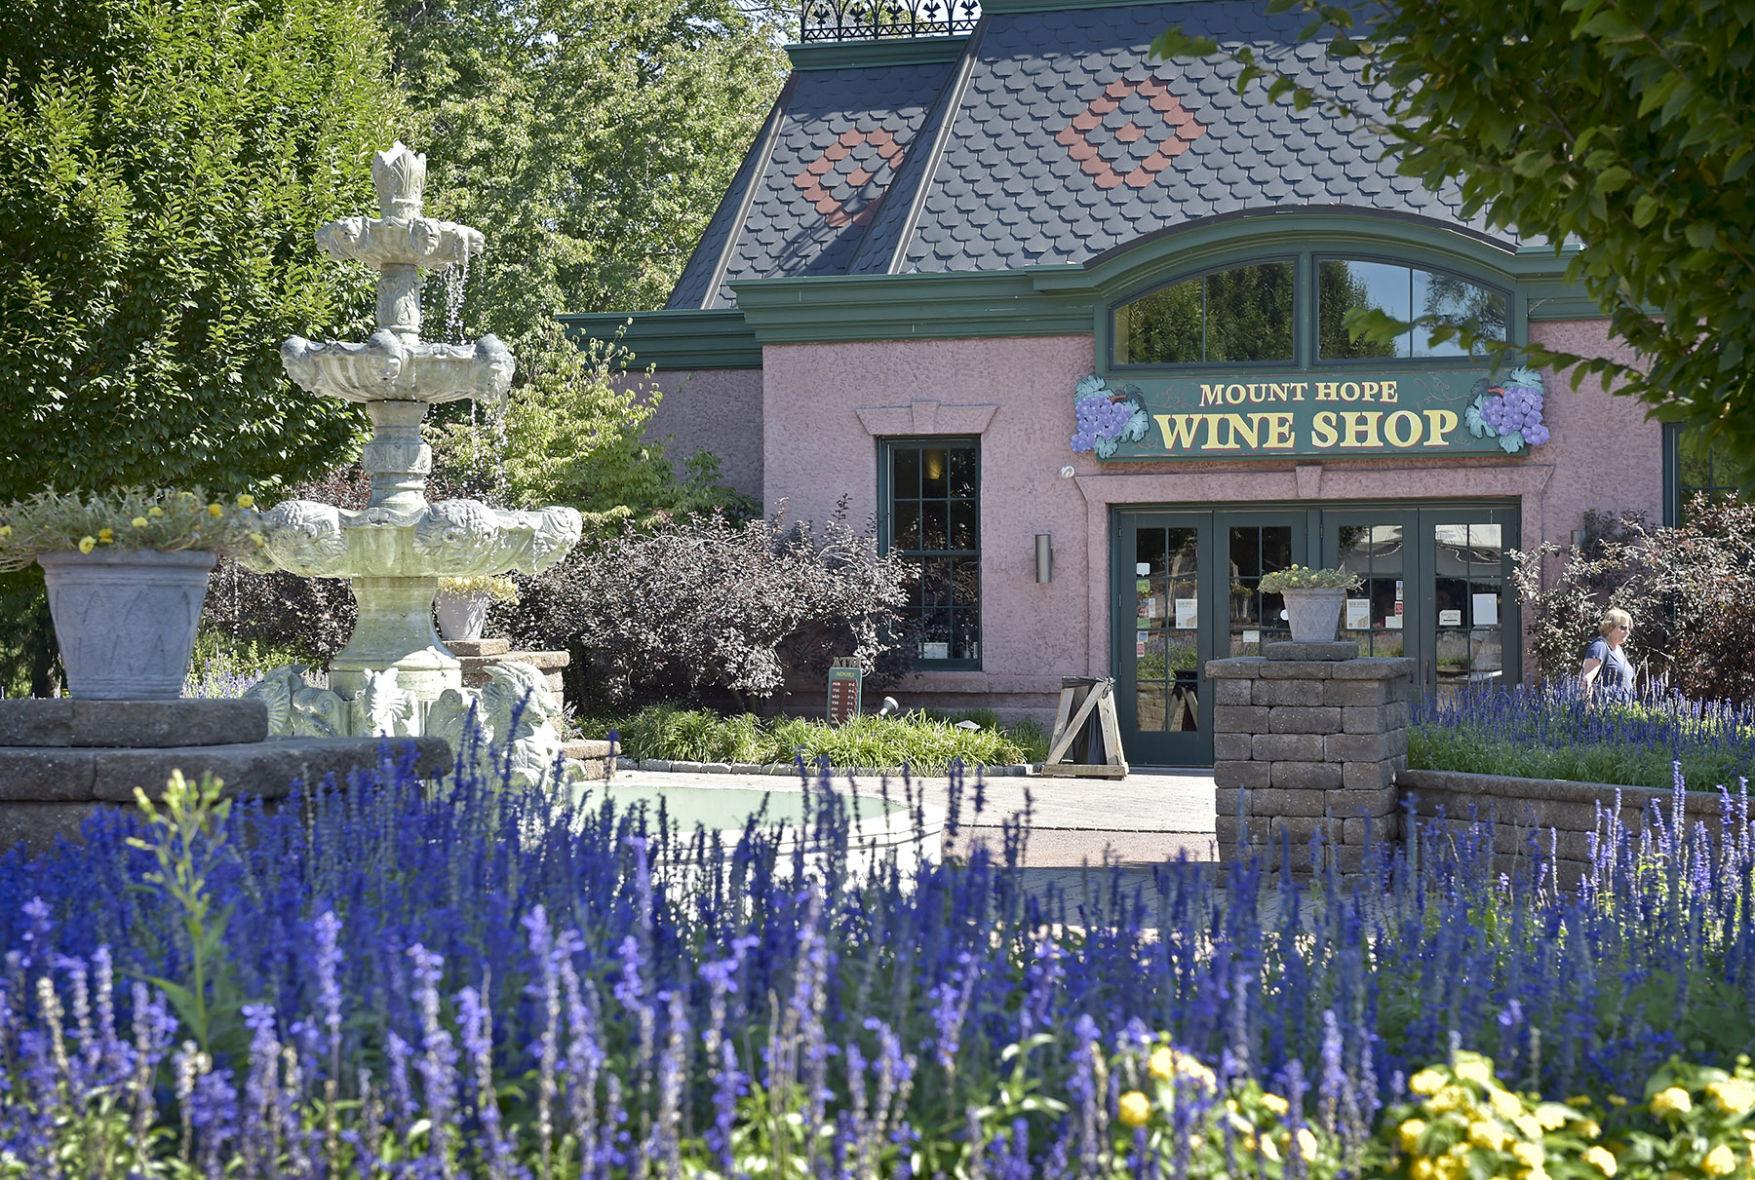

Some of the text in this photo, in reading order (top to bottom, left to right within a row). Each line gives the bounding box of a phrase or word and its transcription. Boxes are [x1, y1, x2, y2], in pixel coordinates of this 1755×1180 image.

[1199, 381, 1398, 407] MOUNT HOPE
[1153, 409, 1458, 450] WINE SHOP
